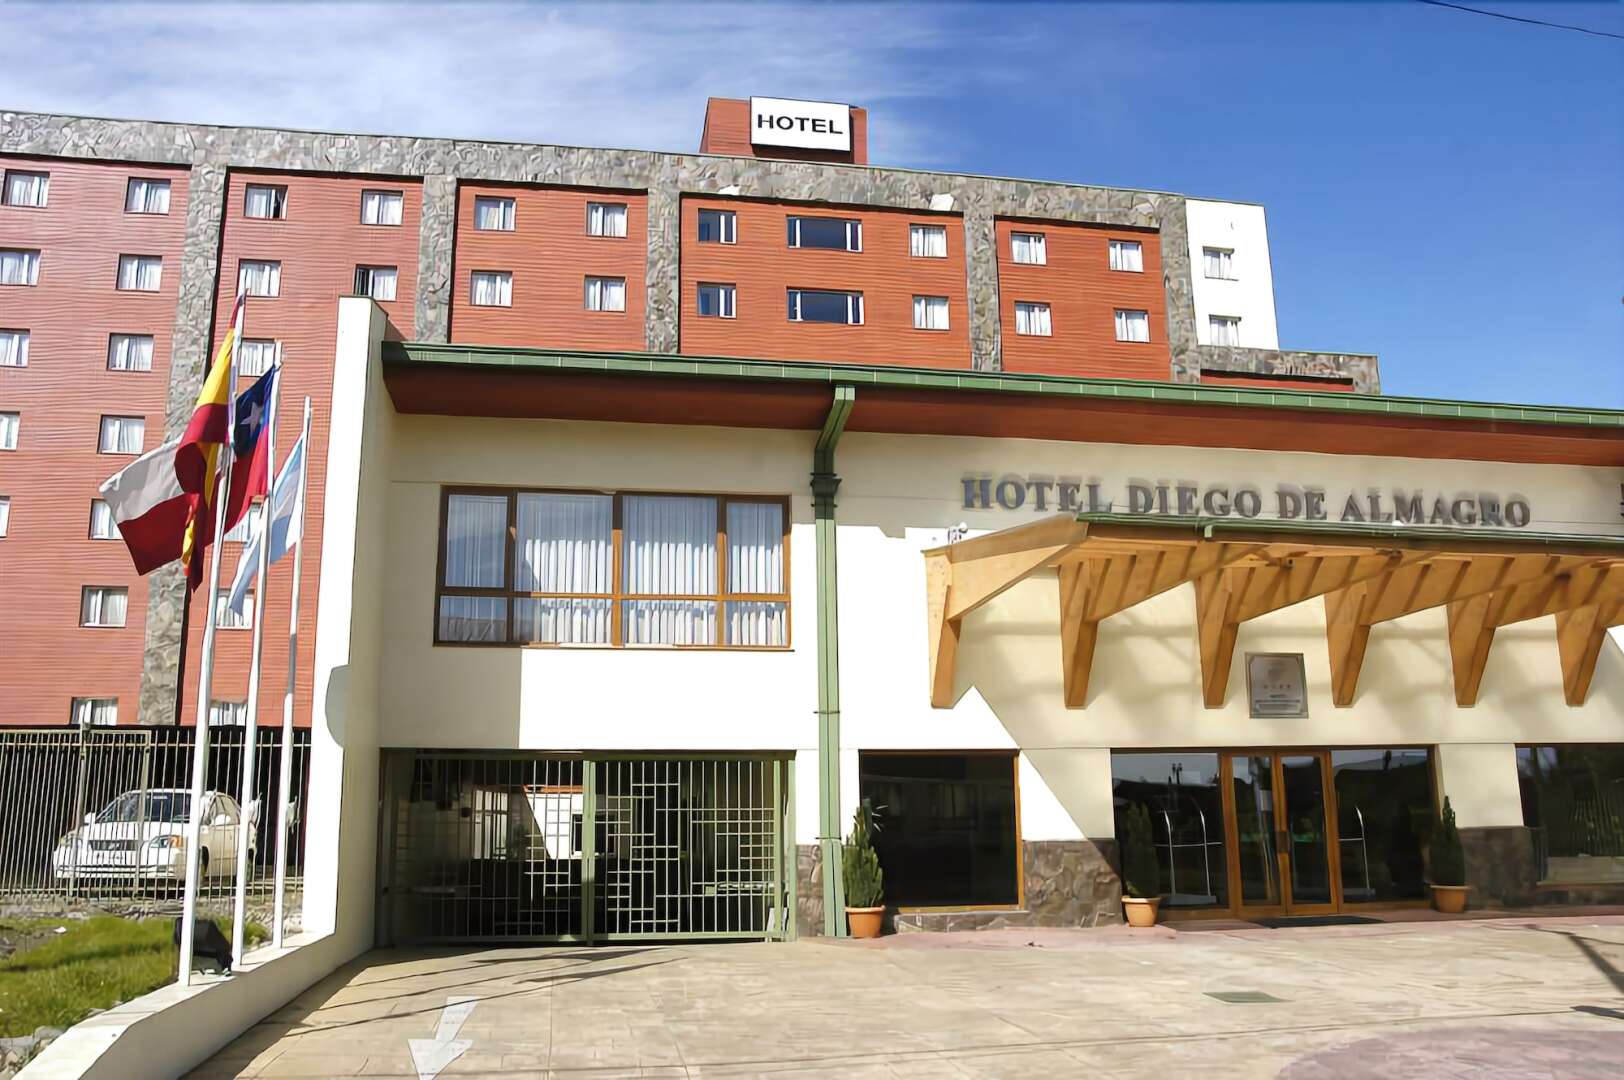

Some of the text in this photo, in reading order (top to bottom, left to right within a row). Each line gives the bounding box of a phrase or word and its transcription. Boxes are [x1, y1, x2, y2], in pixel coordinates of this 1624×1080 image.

[757, 114, 843, 134] HOTEL
[961, 477, 1531, 528] HOTEL DIEGO DE ALMAGRO
